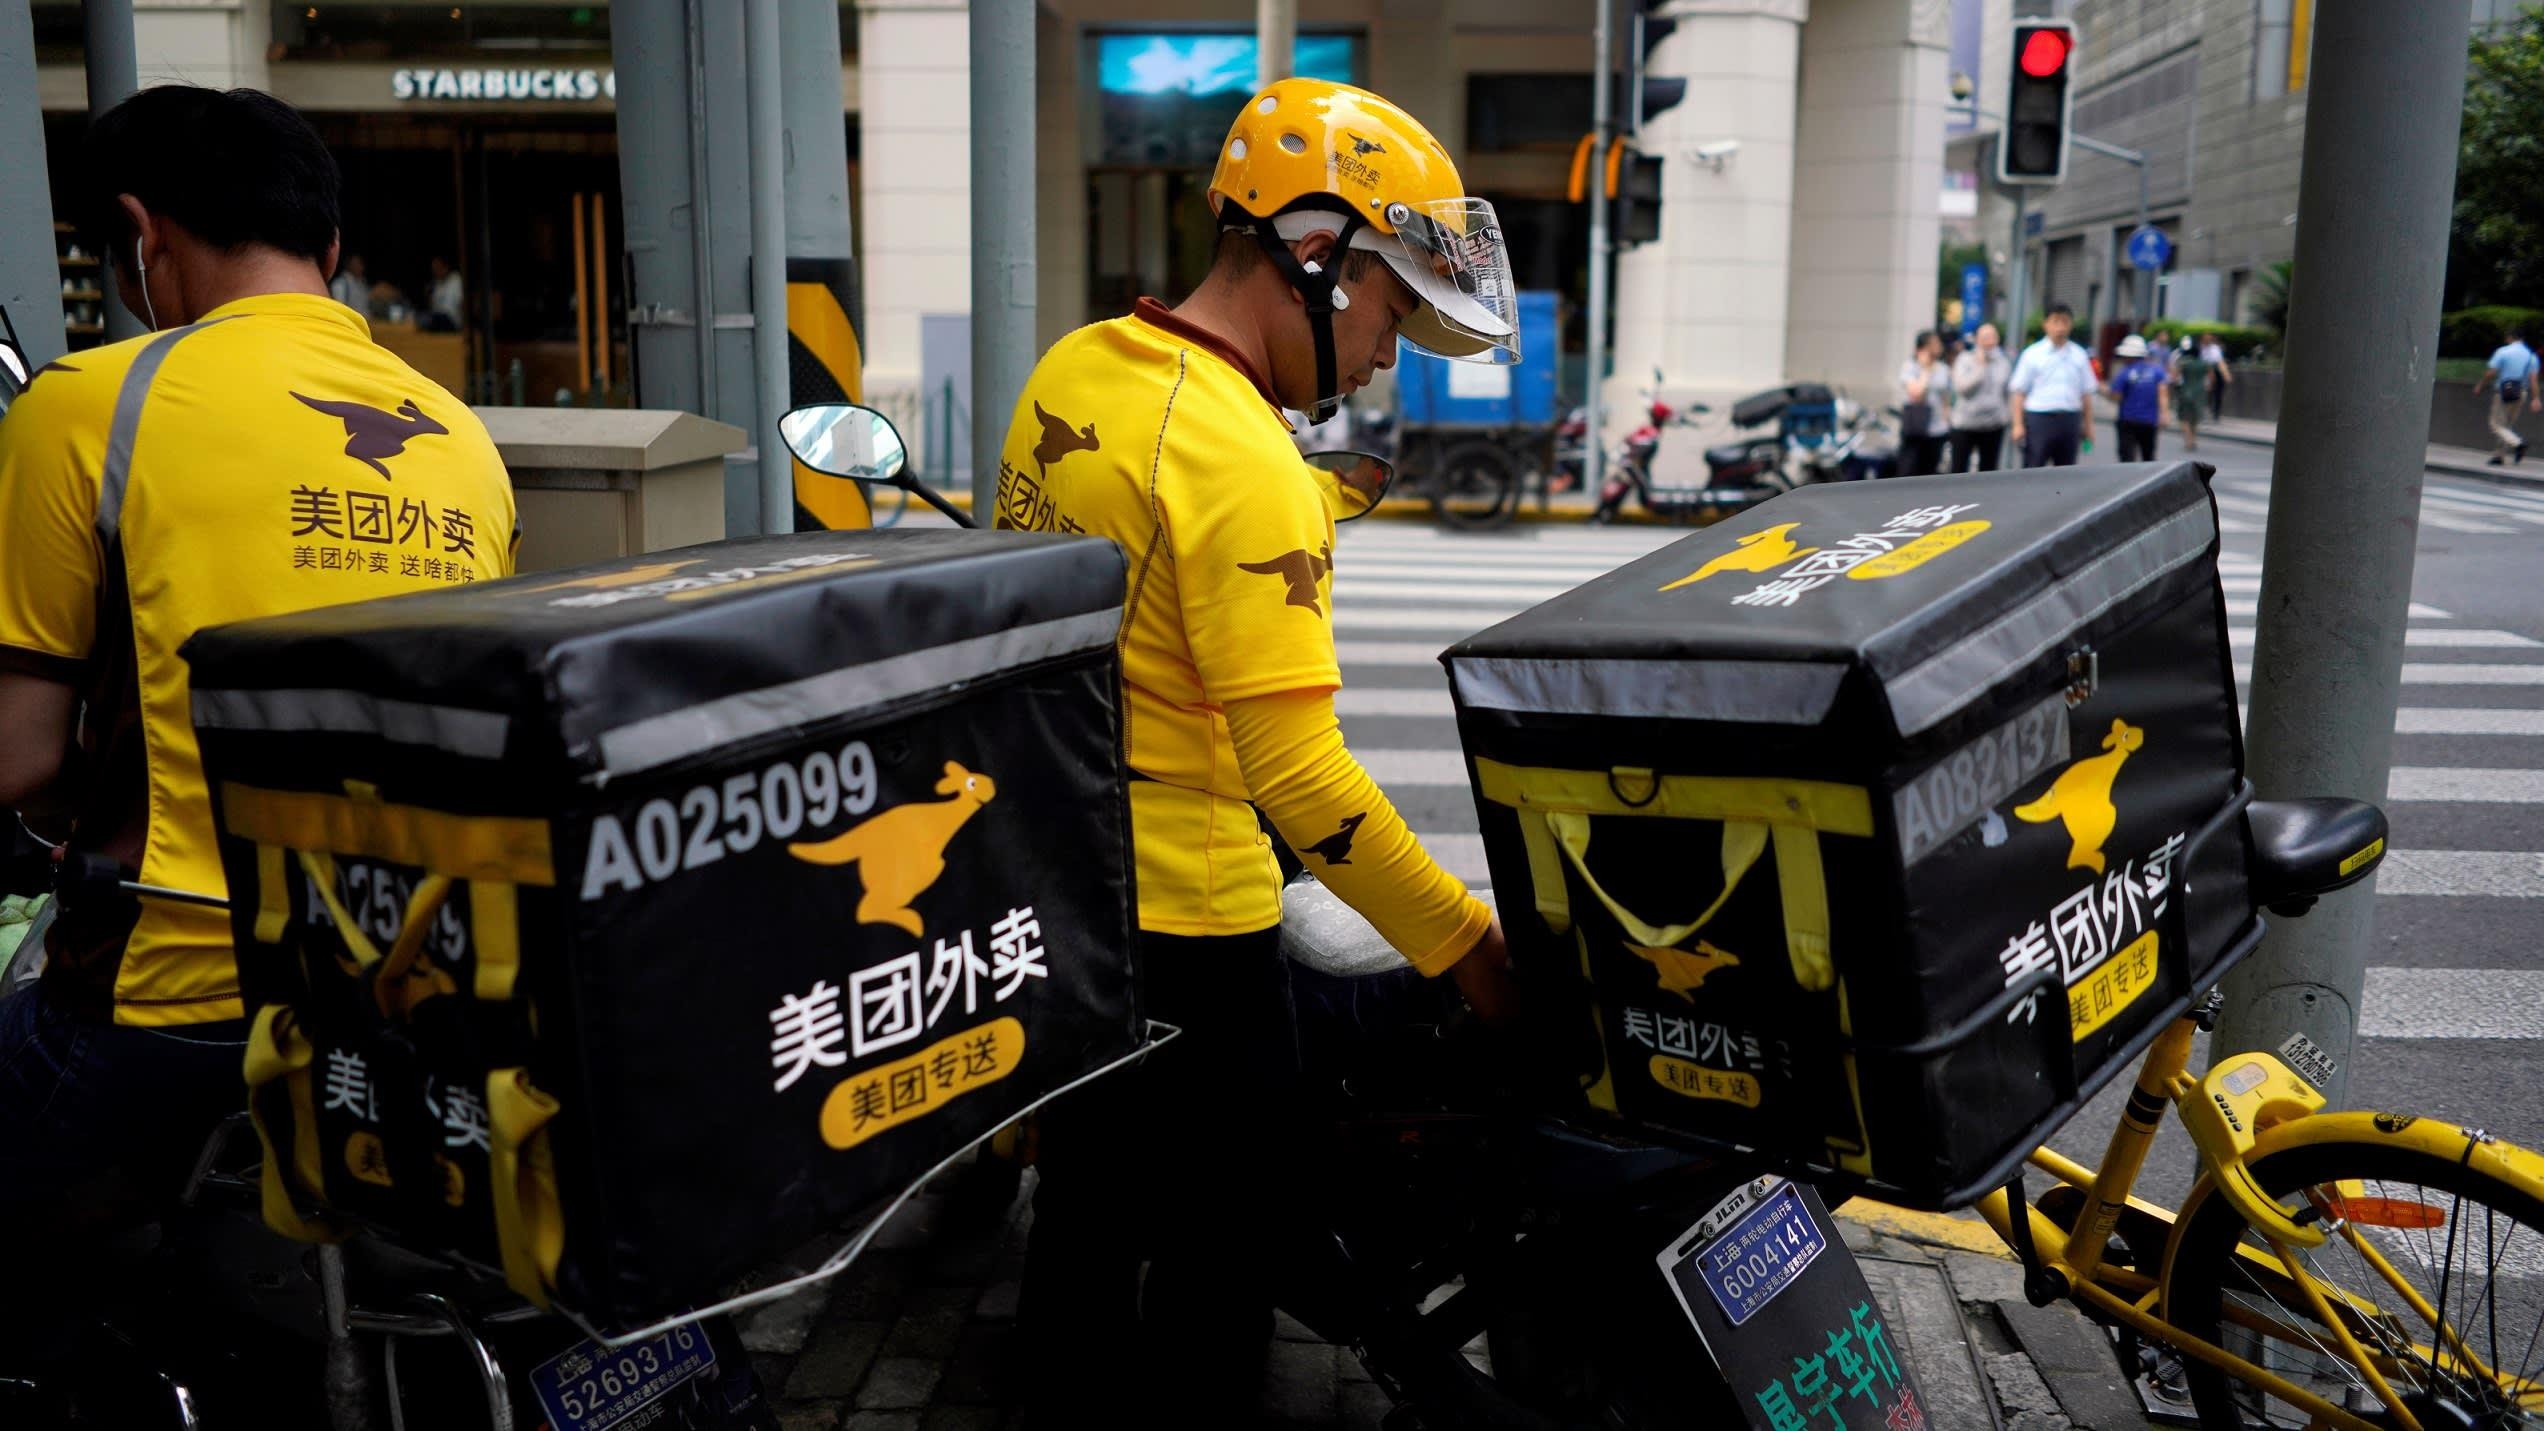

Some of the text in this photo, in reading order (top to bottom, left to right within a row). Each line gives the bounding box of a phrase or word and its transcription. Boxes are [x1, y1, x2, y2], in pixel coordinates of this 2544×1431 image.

[392, 68, 598, 99] STARBUCKS
[1328, 150, 1381, 185] 美团外卖
[290, 484, 476, 560] 美团外卖
[293, 545, 476, 584] 美团外卖 送啥都快
[1730, 502, 1981, 607] 美团外卖
[579, 741, 878, 901] A025099
[1904, 698, 2070, 861] A082137
[768, 905, 1048, 1094] 美团外卖
[2071, 943, 2150, 1028] 美团专送
[850, 1030, 998, 1132] 美团专送
[1663, 1064, 1751, 1100] 美团专送
[1713, 1199, 1793, 1273] 上海 两轮电动自行车
[1722, 1214, 1809, 1300] 6004141
[560, 1324, 695, 1421] 5269376
